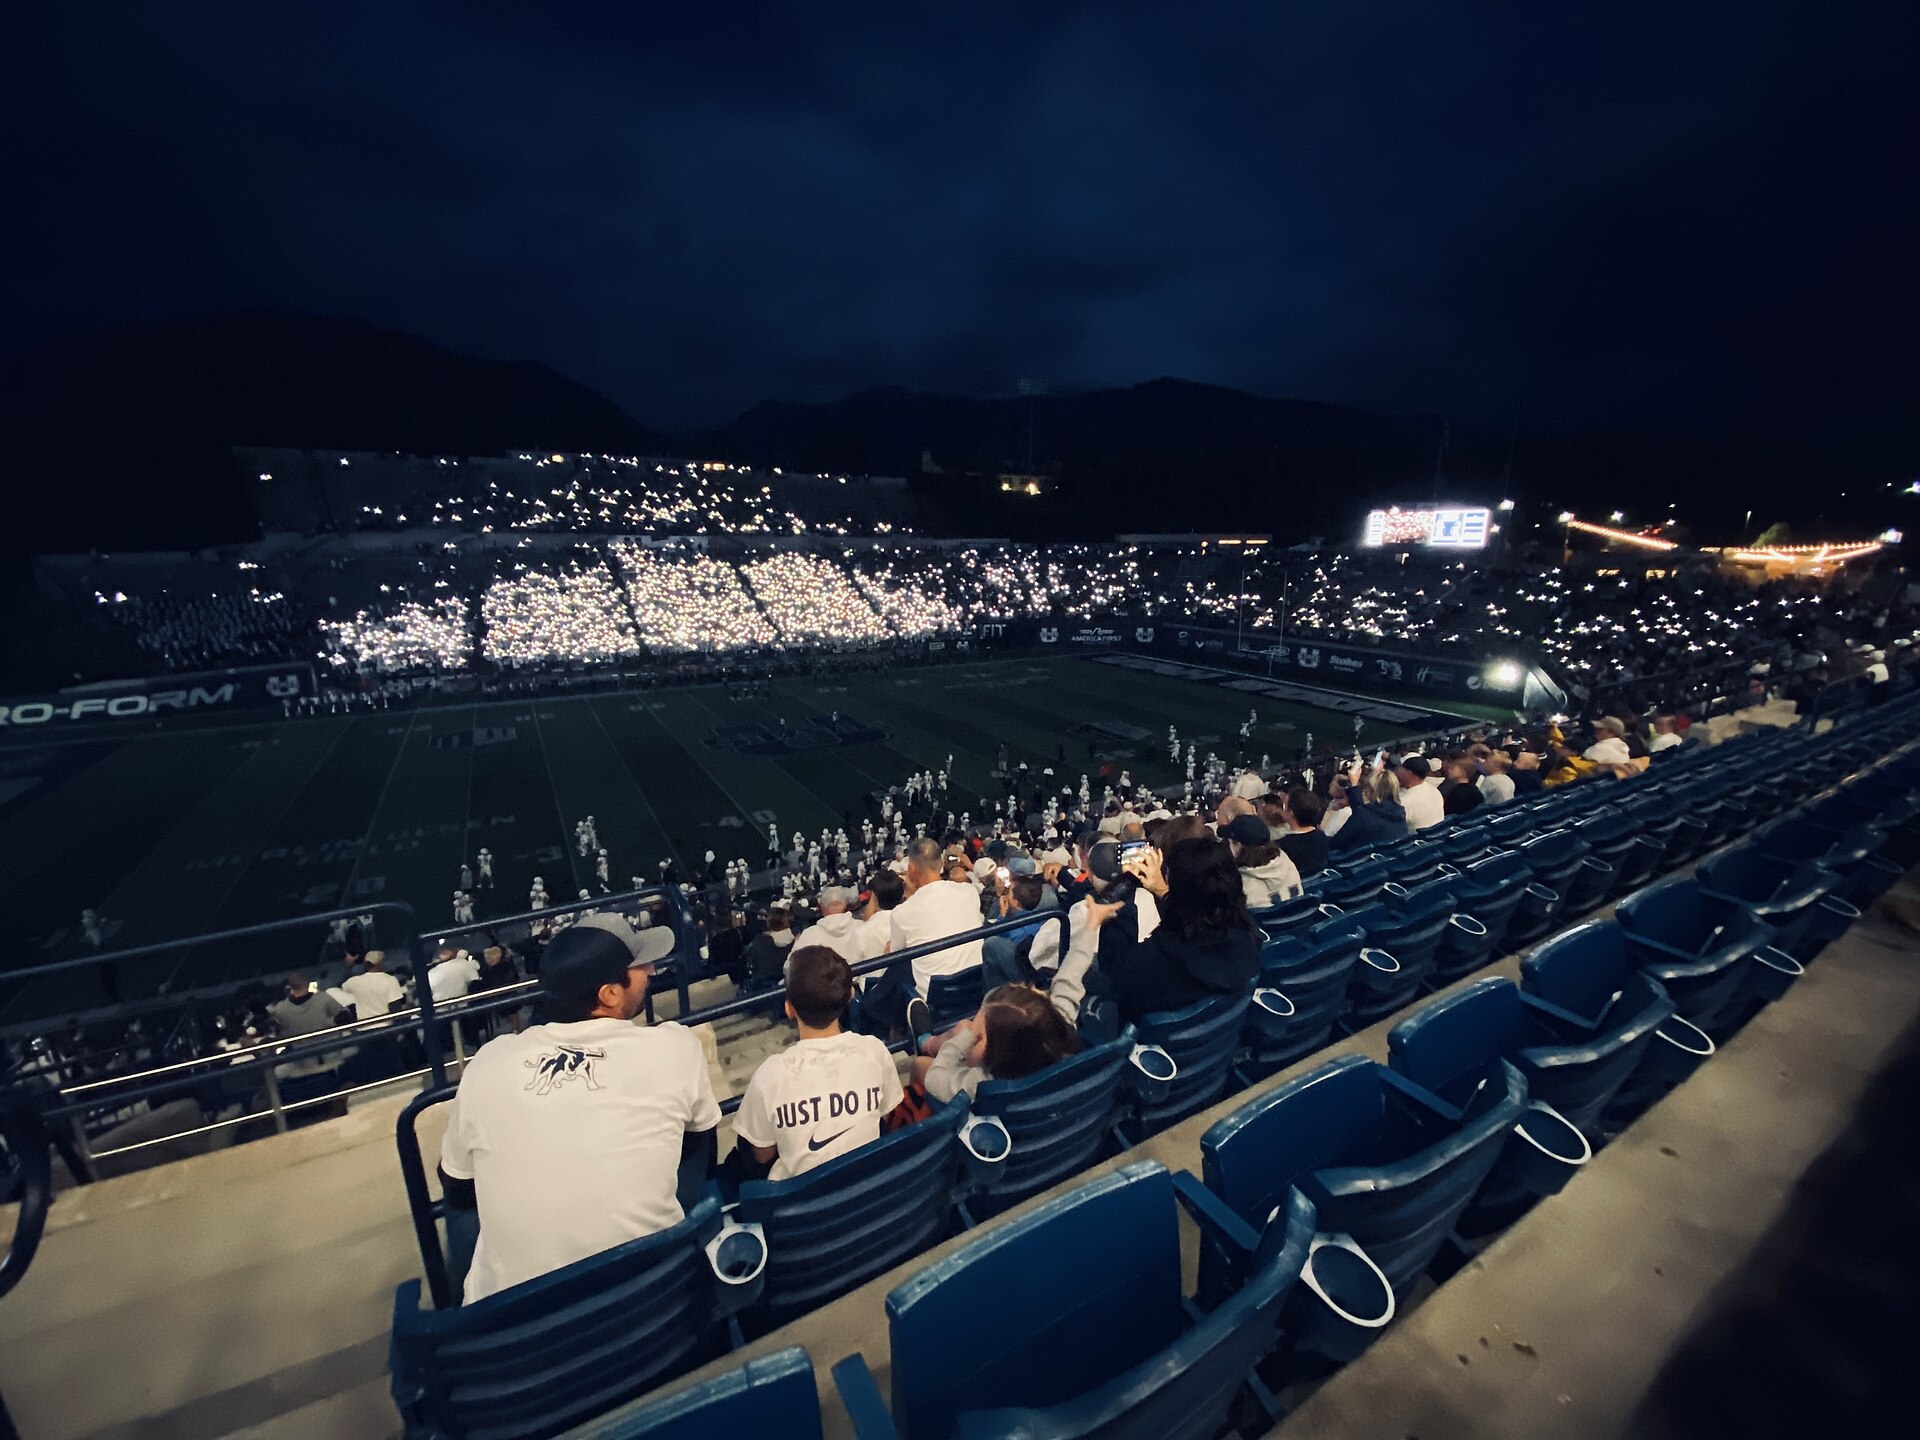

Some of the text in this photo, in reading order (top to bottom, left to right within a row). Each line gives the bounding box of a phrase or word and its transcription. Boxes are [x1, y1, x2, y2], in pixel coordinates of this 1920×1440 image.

[0, 684, 235, 726] O-FORM
[776, 1086, 880, 1129] JUST DO IT
